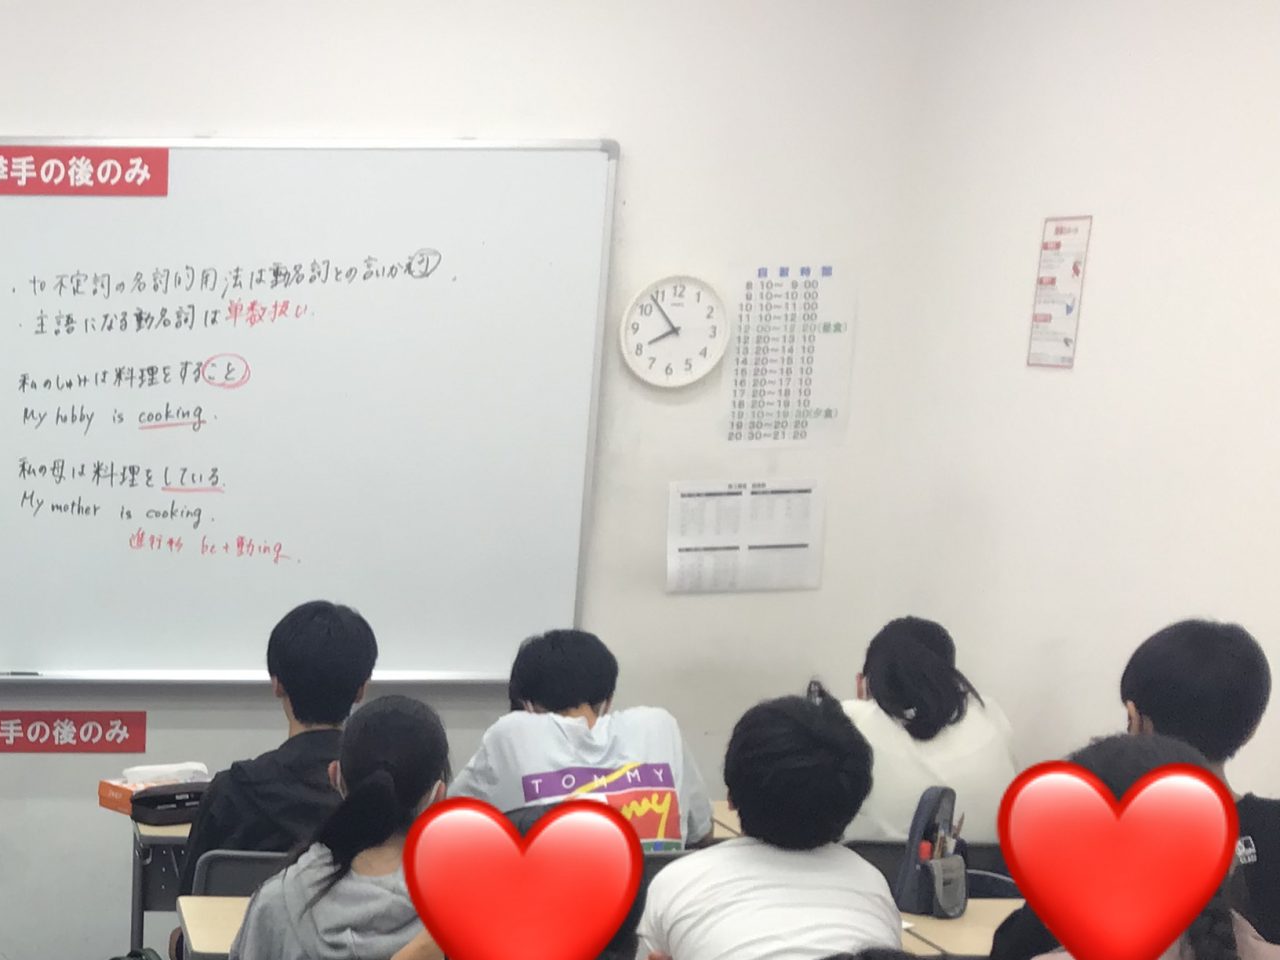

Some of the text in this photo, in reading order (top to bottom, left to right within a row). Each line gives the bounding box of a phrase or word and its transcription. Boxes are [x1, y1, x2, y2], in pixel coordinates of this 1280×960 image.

[672, 284, 687, 299] 12
[695, 290, 702, 304] 1
[639, 303, 653, 317] 10
[706, 305, 715, 320] 2
[630, 321, 640, 336] 9
[709, 325, 718, 339] 3
[635, 342, 644, 357] 8
[699, 346, 708, 359] 4
[648, 356, 657, 370] 7
[664, 363, 674, 376] 6
[684, 357, 693, 372] 5
[23, 406, 47, 429] My
[55, 404, 95, 436] hobby
[113, 409, 124, 424] is
[20, 491, 44, 517] My
[51, 496, 101, 517] mother
[120, 504, 132, 520] is
[531, 768, 665, 795] TOMMY
